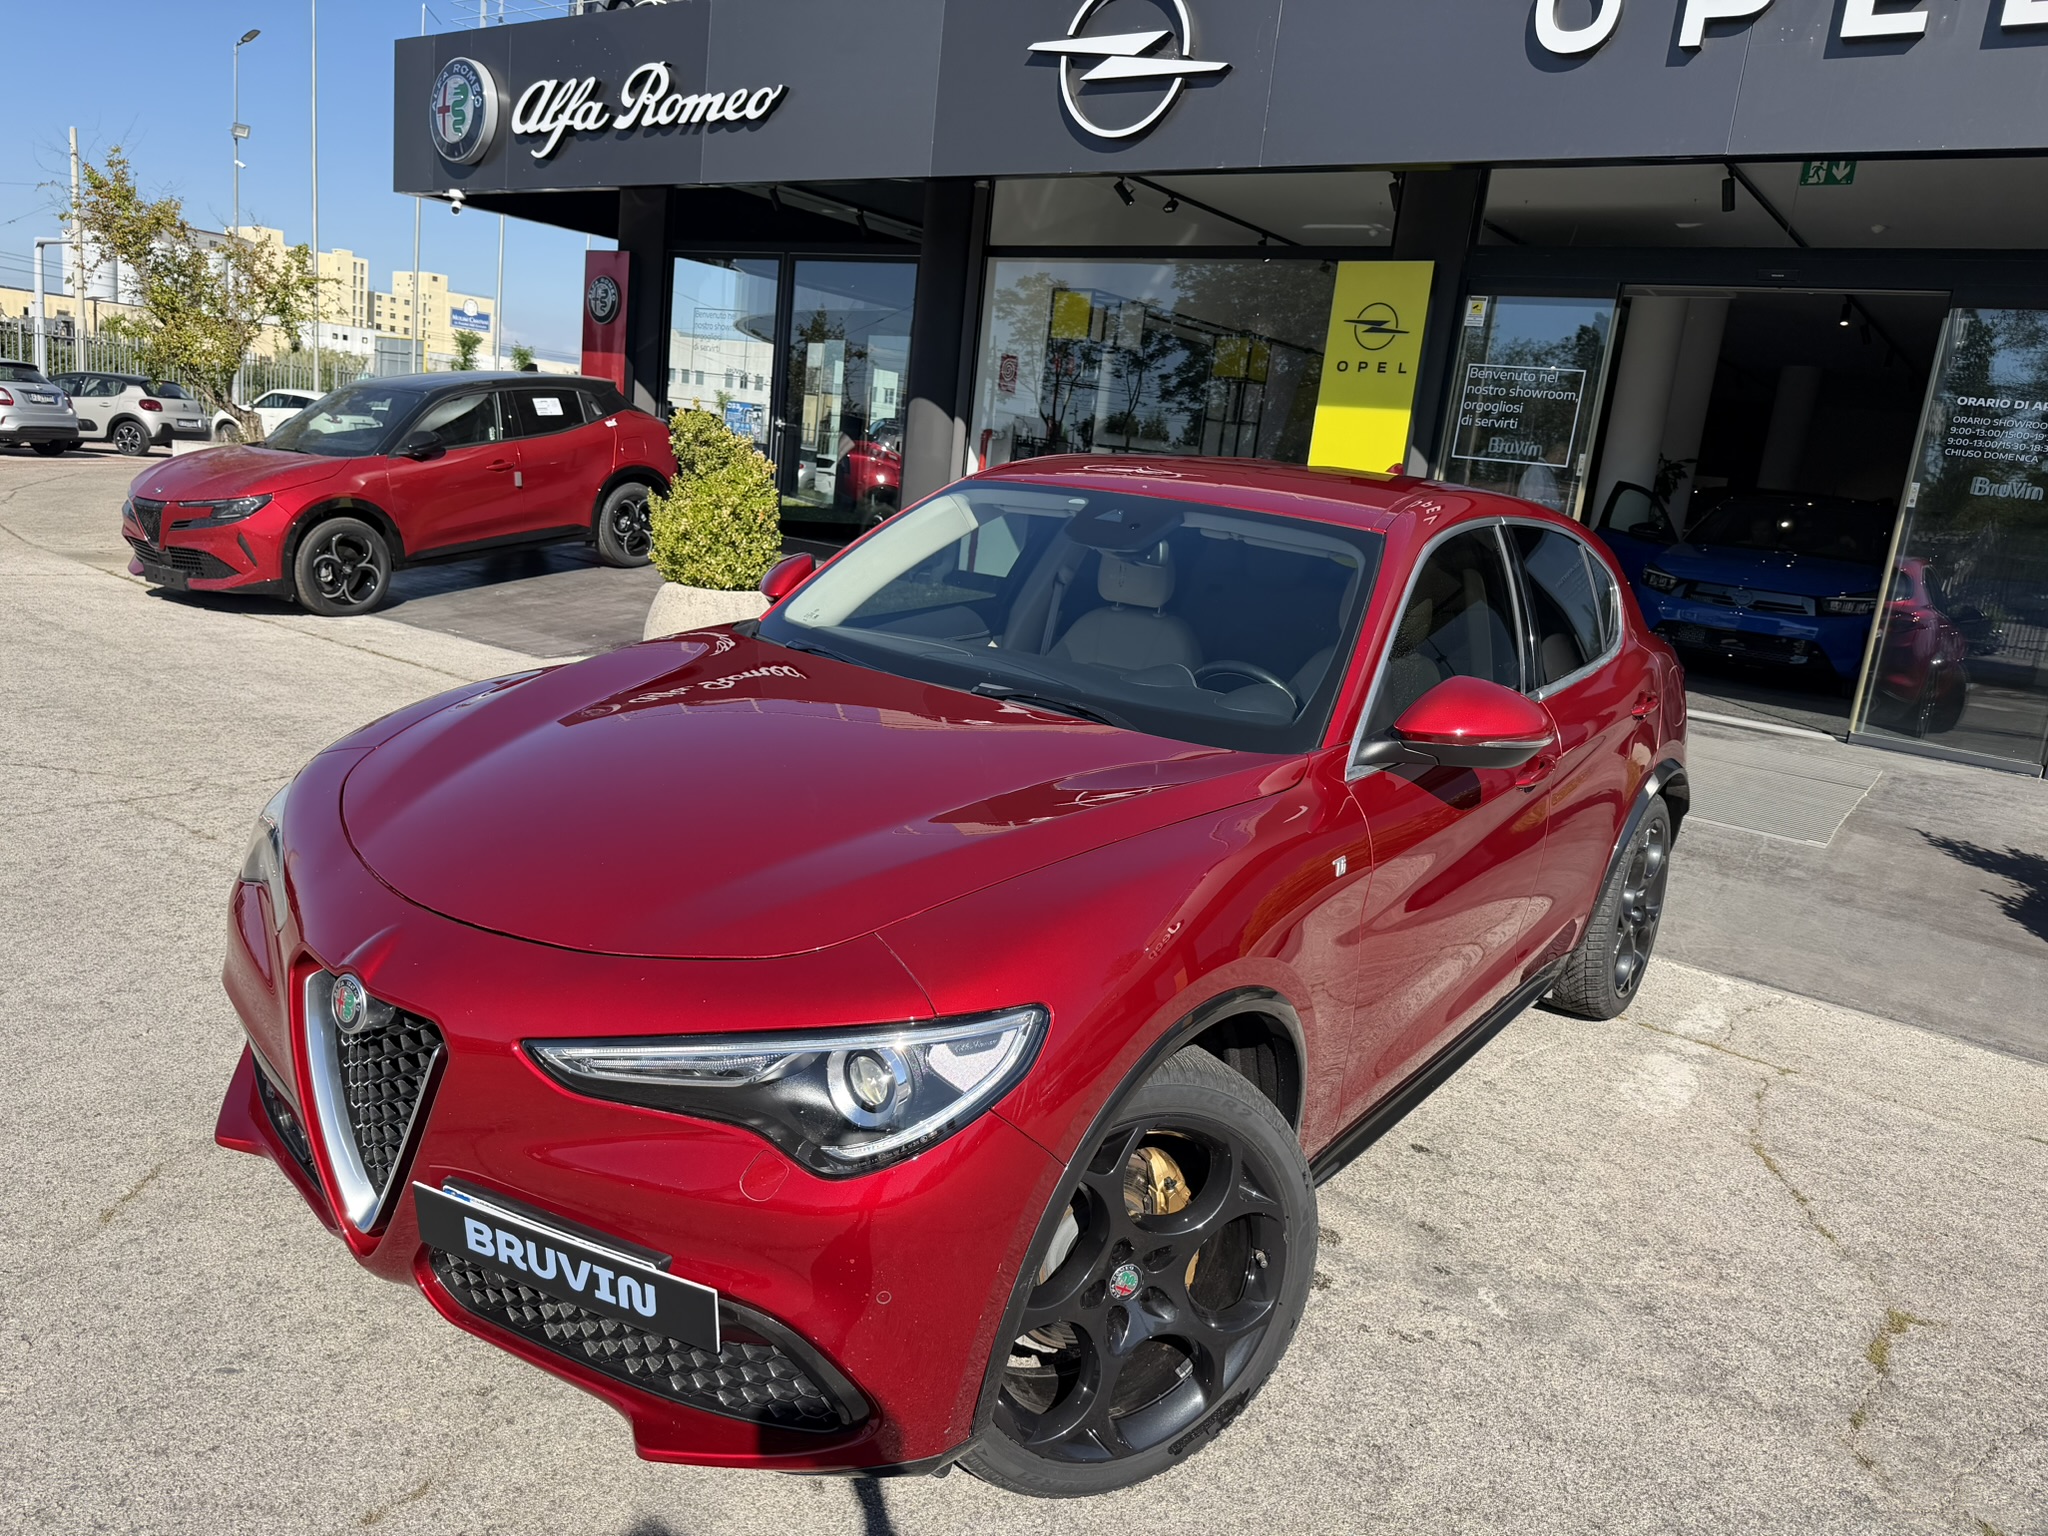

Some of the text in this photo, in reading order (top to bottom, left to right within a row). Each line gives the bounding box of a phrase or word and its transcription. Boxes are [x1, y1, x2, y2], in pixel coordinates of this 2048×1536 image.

[1535, 0, 2048, 53] OP
[453, 64, 482, 107] ROMEO
[512, 61, 783, 158] Alfa Romeo
[1336, 361, 1407, 374] OPEL
[1469, 367, 1559, 383] Benvenuto nel
[1466, 384, 1579, 403] nostro showroom,
[1463, 401, 1524, 415] orgogliosi
[1957, 396, 2010, 408] ORARIO
[2014, 400, 2029, 410] DI
[1461, 414, 1518, 429] di servirti
[1952, 416, 1991, 426] ORARIO
[1945, 448, 2039, 463] CHIUSO DOMENICA
[464, 1216, 657, 1317] BRUVIN
